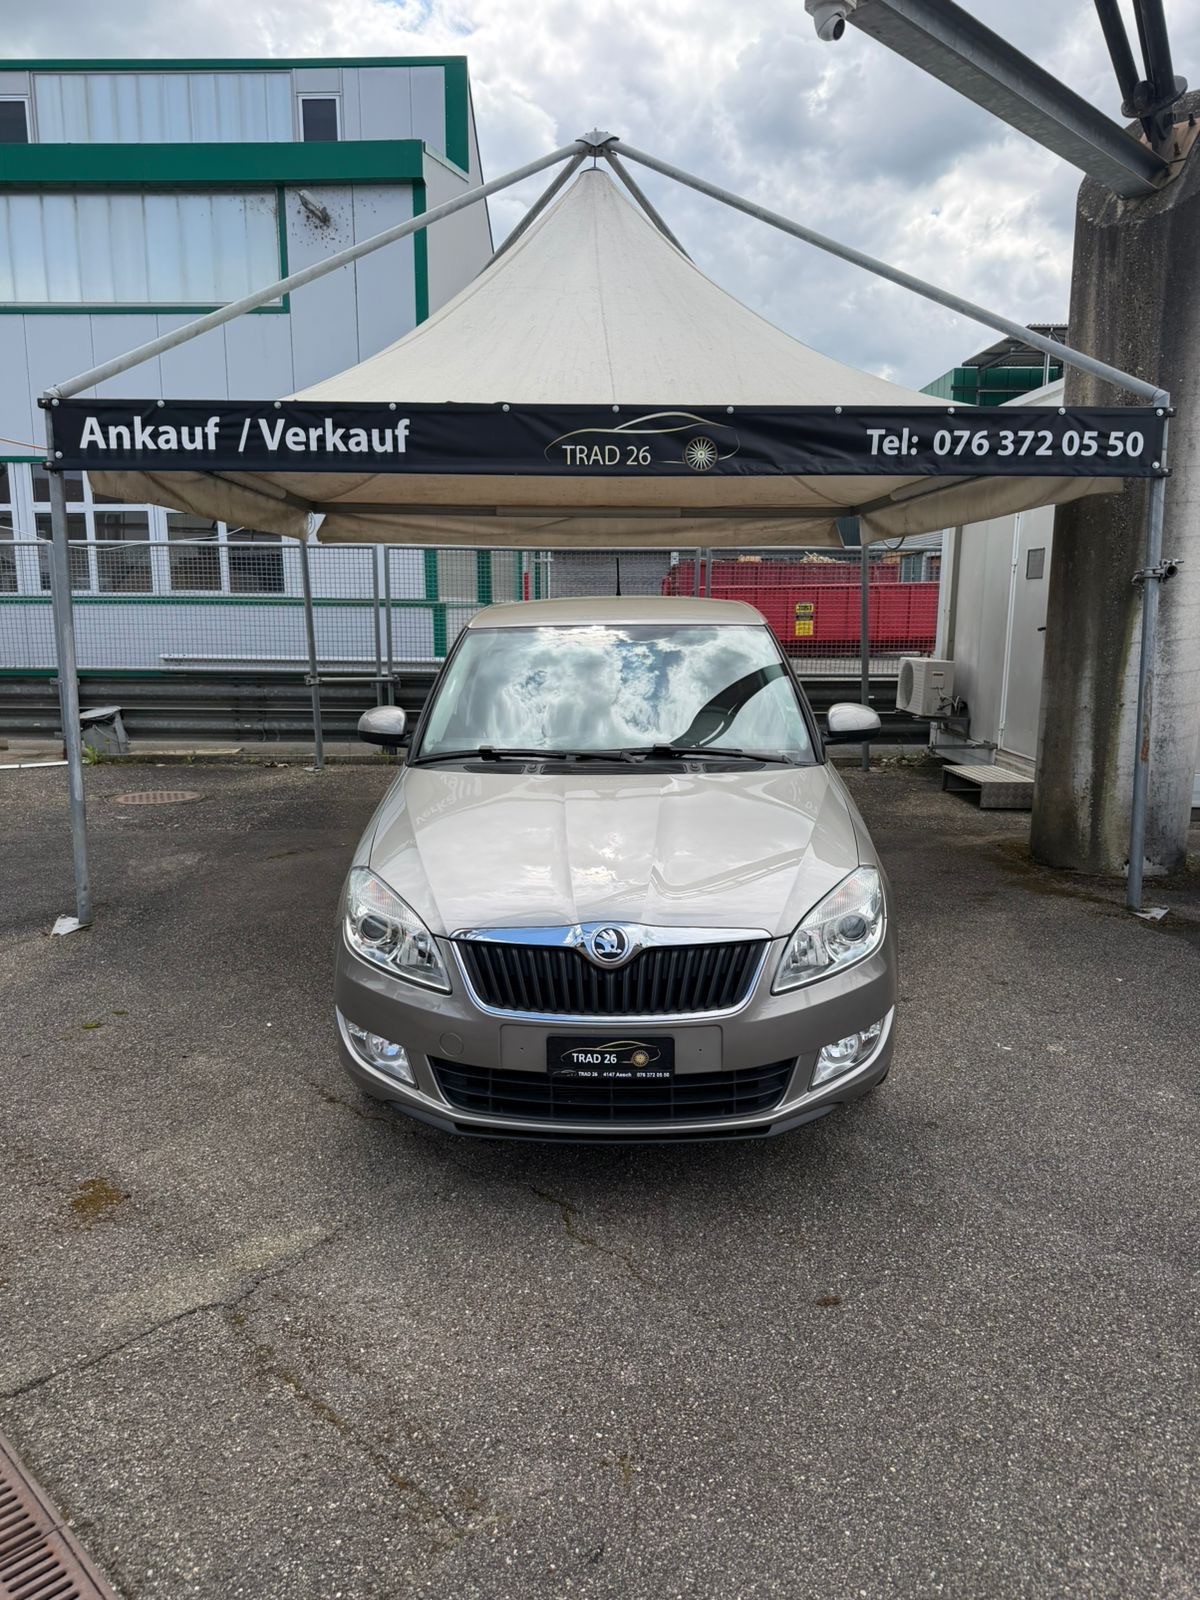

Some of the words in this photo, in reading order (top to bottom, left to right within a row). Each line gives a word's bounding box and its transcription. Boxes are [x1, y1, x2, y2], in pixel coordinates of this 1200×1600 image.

[79, 416, 220, 450] Ankauf
[866, 429, 919, 456] Tel:
[933, 429, 990, 456] 076
[997, 430, 1053, 456] 372
[1061, 430, 1098, 457] 05
[1106, 431, 1144, 457] 50
[562, 445, 620, 466] TRAD
[626, 445, 651, 466] 26
[572, 1053, 601, 1064] TRAD
[604, 1053, 617, 1064] 26
